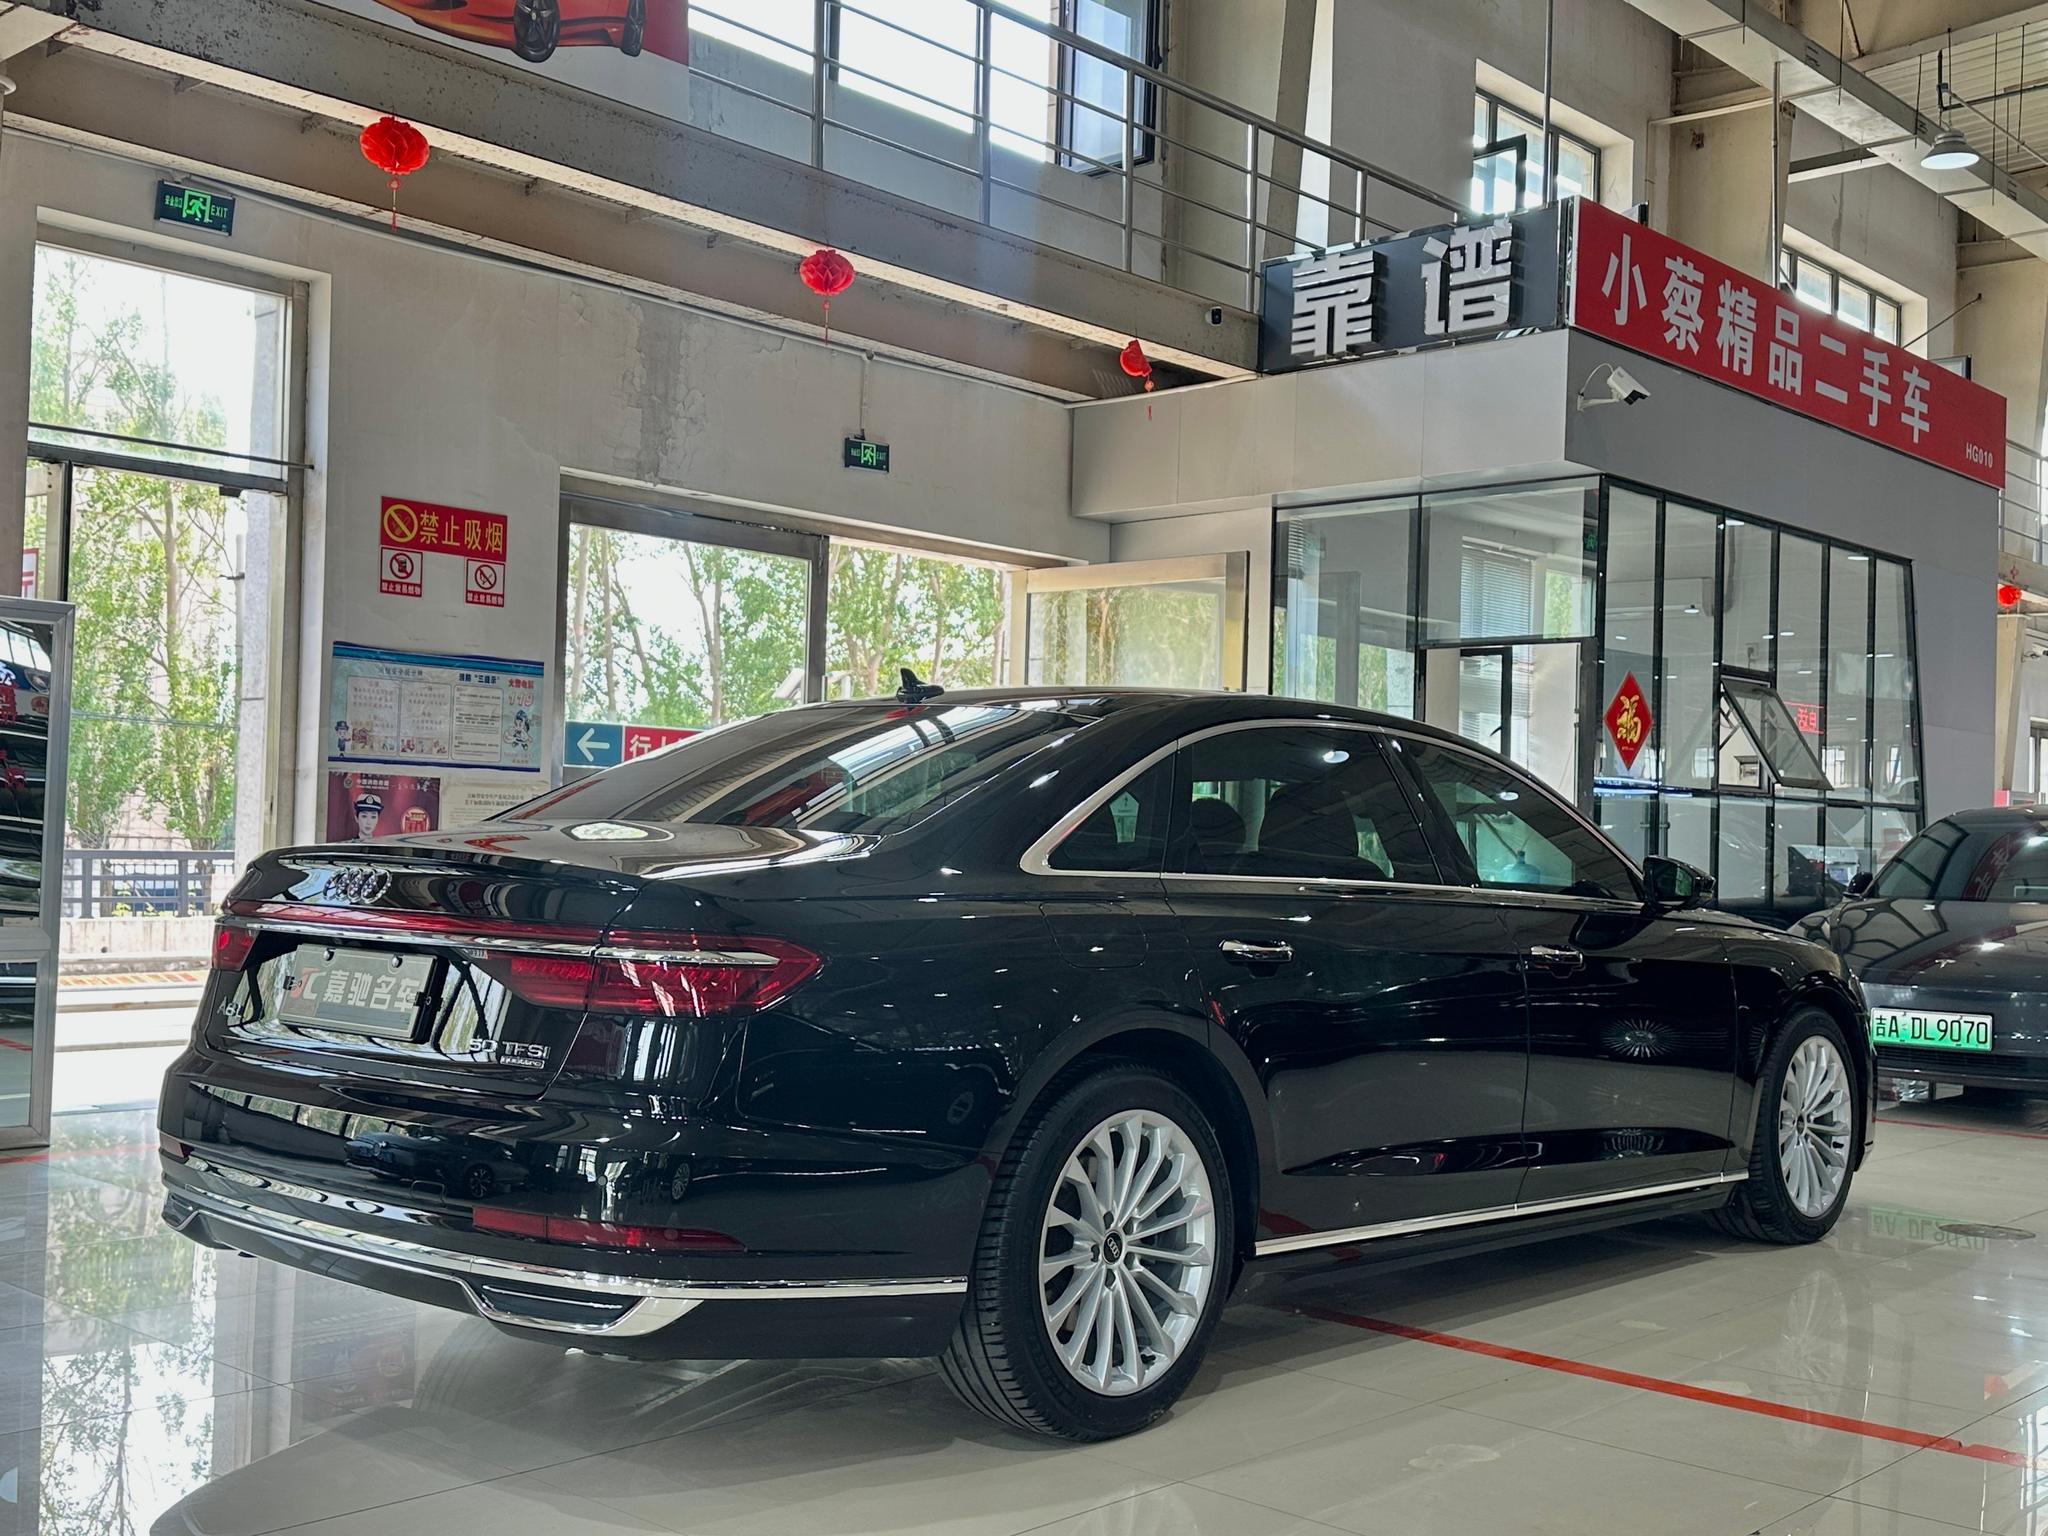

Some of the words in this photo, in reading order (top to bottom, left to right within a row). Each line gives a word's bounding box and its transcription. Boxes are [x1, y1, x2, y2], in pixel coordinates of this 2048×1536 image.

[210, 204, 228, 218] EXIT
[1291, 218, 1512, 357] 靠谱
[1602, 234, 1930, 444] 小蔡精品二手车
[1965, 442, 1993, 469] HG010
[420, 509, 503, 554] 禁止吸烟
[1616, 695, 1641, 743] 福
[323, 970, 420, 1012] 嘉驰名车
[470, 1038, 498, 1053] 50
[502, 1041, 551, 1059] TFSI
[1911, 1017, 1988, 1045] DL9070
